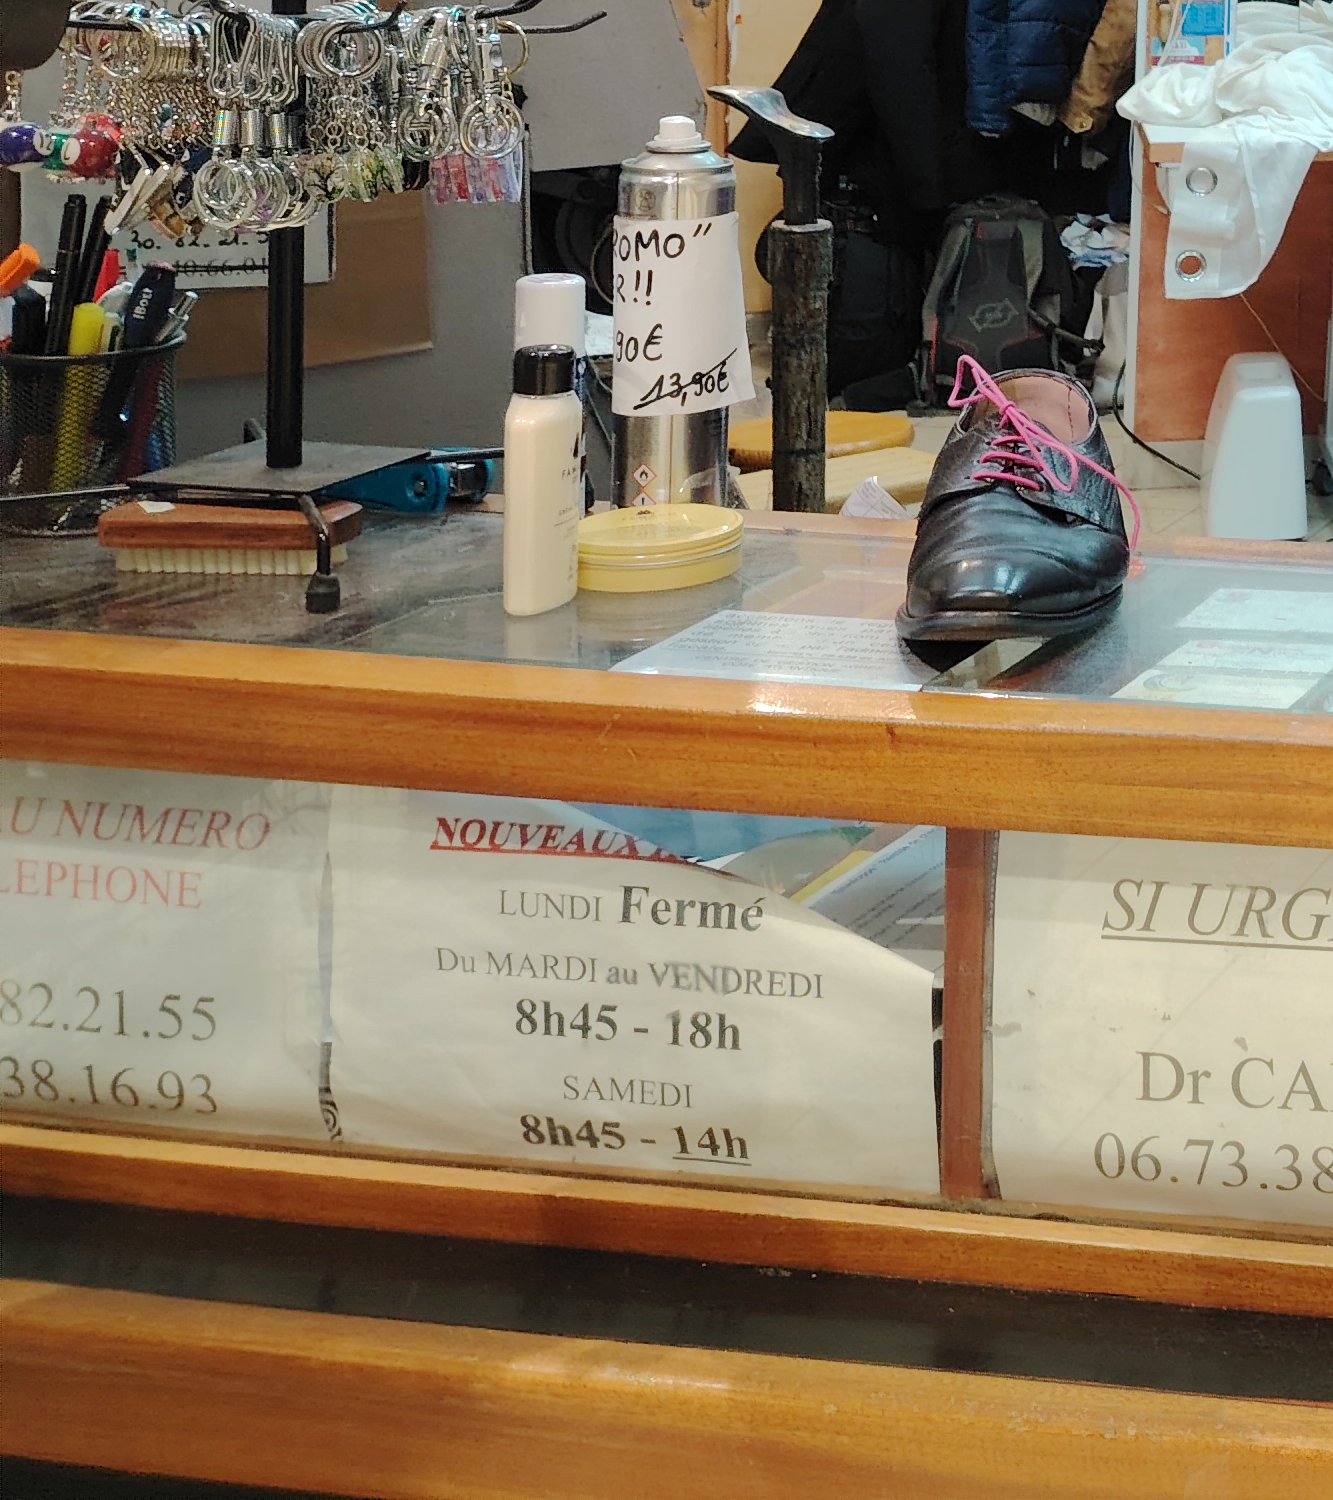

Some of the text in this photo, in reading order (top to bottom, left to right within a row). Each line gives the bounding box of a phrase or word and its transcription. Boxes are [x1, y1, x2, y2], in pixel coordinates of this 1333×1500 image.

[53, 799, 273, 851] NUMERO
[500, 884, 764, 932] LUNDI Fermé
[1102, 878, 1170, 933] SI
[436, 947, 825, 1000] Du MARDI au VENDREDI
[0, 981, 217, 1042] 82.21.55
[514, 998, 619, 1043] 8h45
[667, 1009, 743, 1051] 18h
[0, 1055, 218, 1115] 38.16.93
[562, 1075, 694, 1109] SAMEDI
[1136, 1050, 1212, 1105] Dr
[519, 1114, 626, 1152] 8h45
[674, 1125, 750, 1161] 14h
